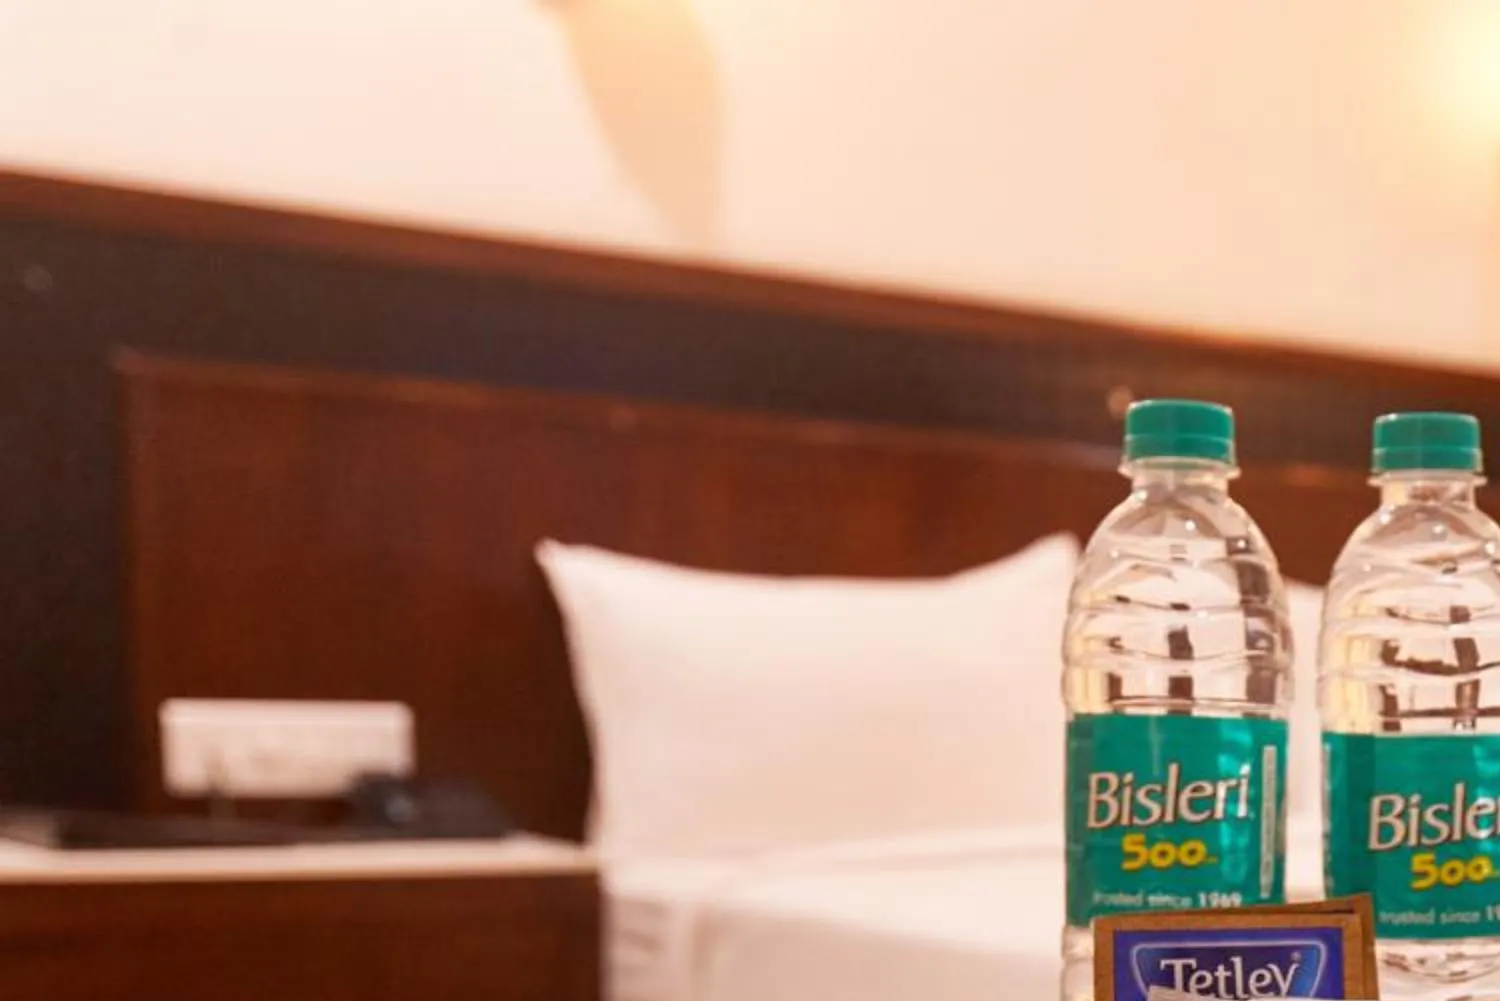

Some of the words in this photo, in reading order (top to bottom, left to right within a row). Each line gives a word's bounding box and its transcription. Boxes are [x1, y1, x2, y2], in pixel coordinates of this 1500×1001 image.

[1087, 762, 1251, 829] Bisleri
[1120, 832, 1208, 872] 500
[1410, 852, 1495, 891] 500
[1147, 889, 1193, 909] since
[1198, 890, 1243, 909] 1969
[1379, 906, 1436, 925] trusted
[1440, 908, 1481, 925] since
[1159, 956, 1300, 1000] Tetley
